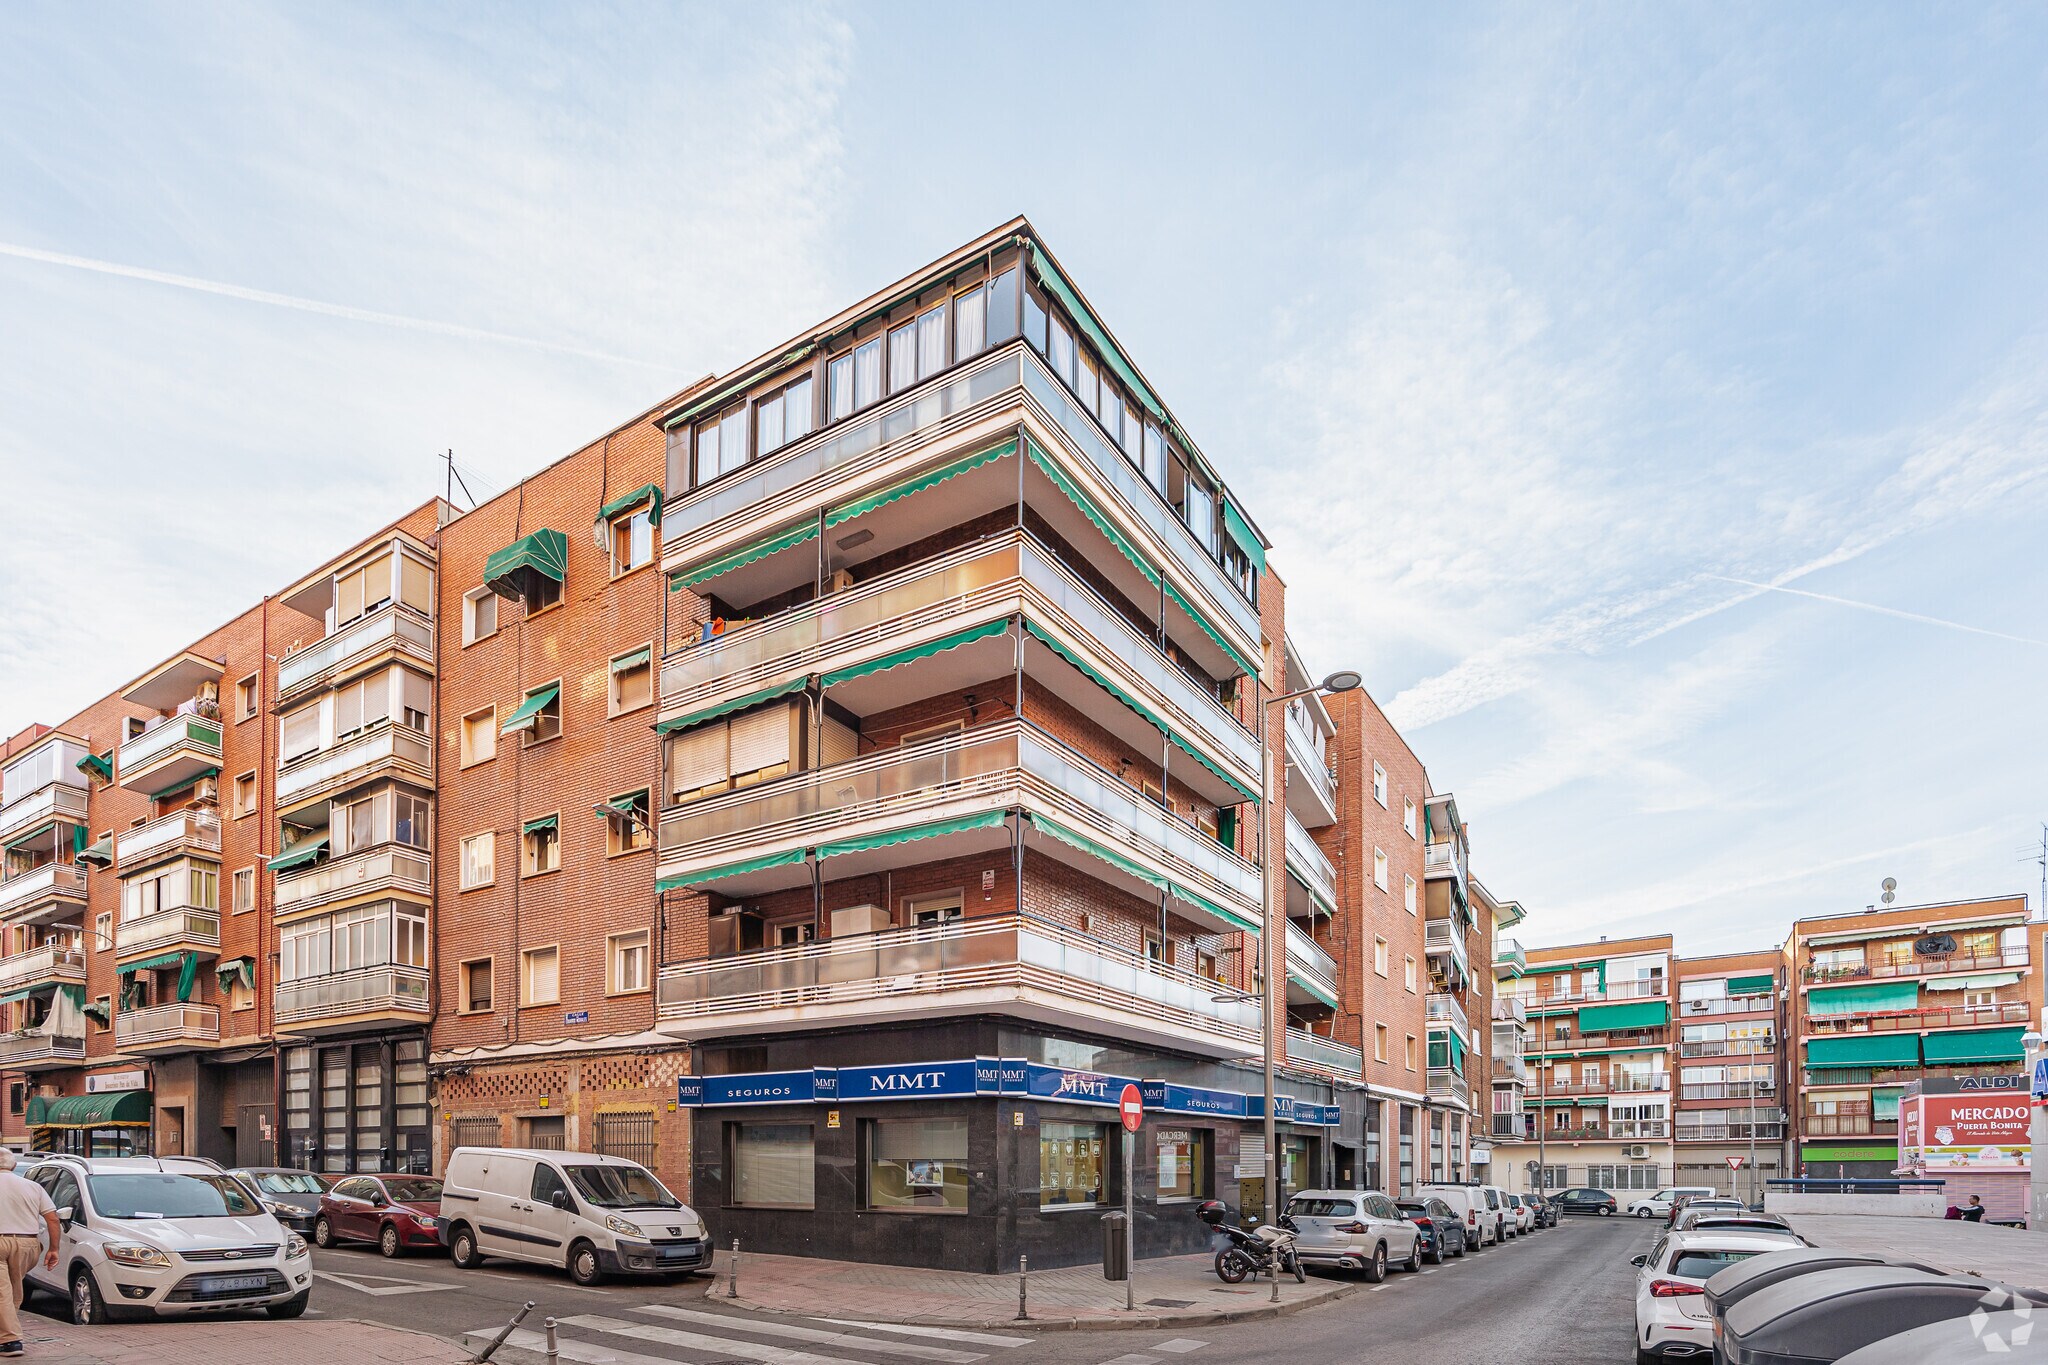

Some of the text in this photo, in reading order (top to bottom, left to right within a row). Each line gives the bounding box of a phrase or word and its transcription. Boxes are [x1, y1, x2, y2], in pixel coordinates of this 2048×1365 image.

[976, 1069, 999, 1078] MMT
[1002, 1069, 1026, 1079] MMT
[815, 1078, 837, 1087] MMT
[870, 1072, 946, 1091] MMT
[1959, 1075, 2019, 1090] ALDI
[680, 1086, 701, 1094] MMT
[1060, 1077, 1108, 1097] MMT
[727, 1087, 791, 1098] SEGUROS
[1144, 1089, 1164, 1097] MMT
[1187, 1100, 1220, 1109] SEGUROS
[1273, 1099, 1295, 1113] MM
[1296, 1112, 1317, 1120] SEGUROS
[1951, 1106, 2029, 1121] MERCADO
[1957, 1121, 2023, 1130] PUERTA BONITA
[1833, 1150, 1876, 1158] codere
